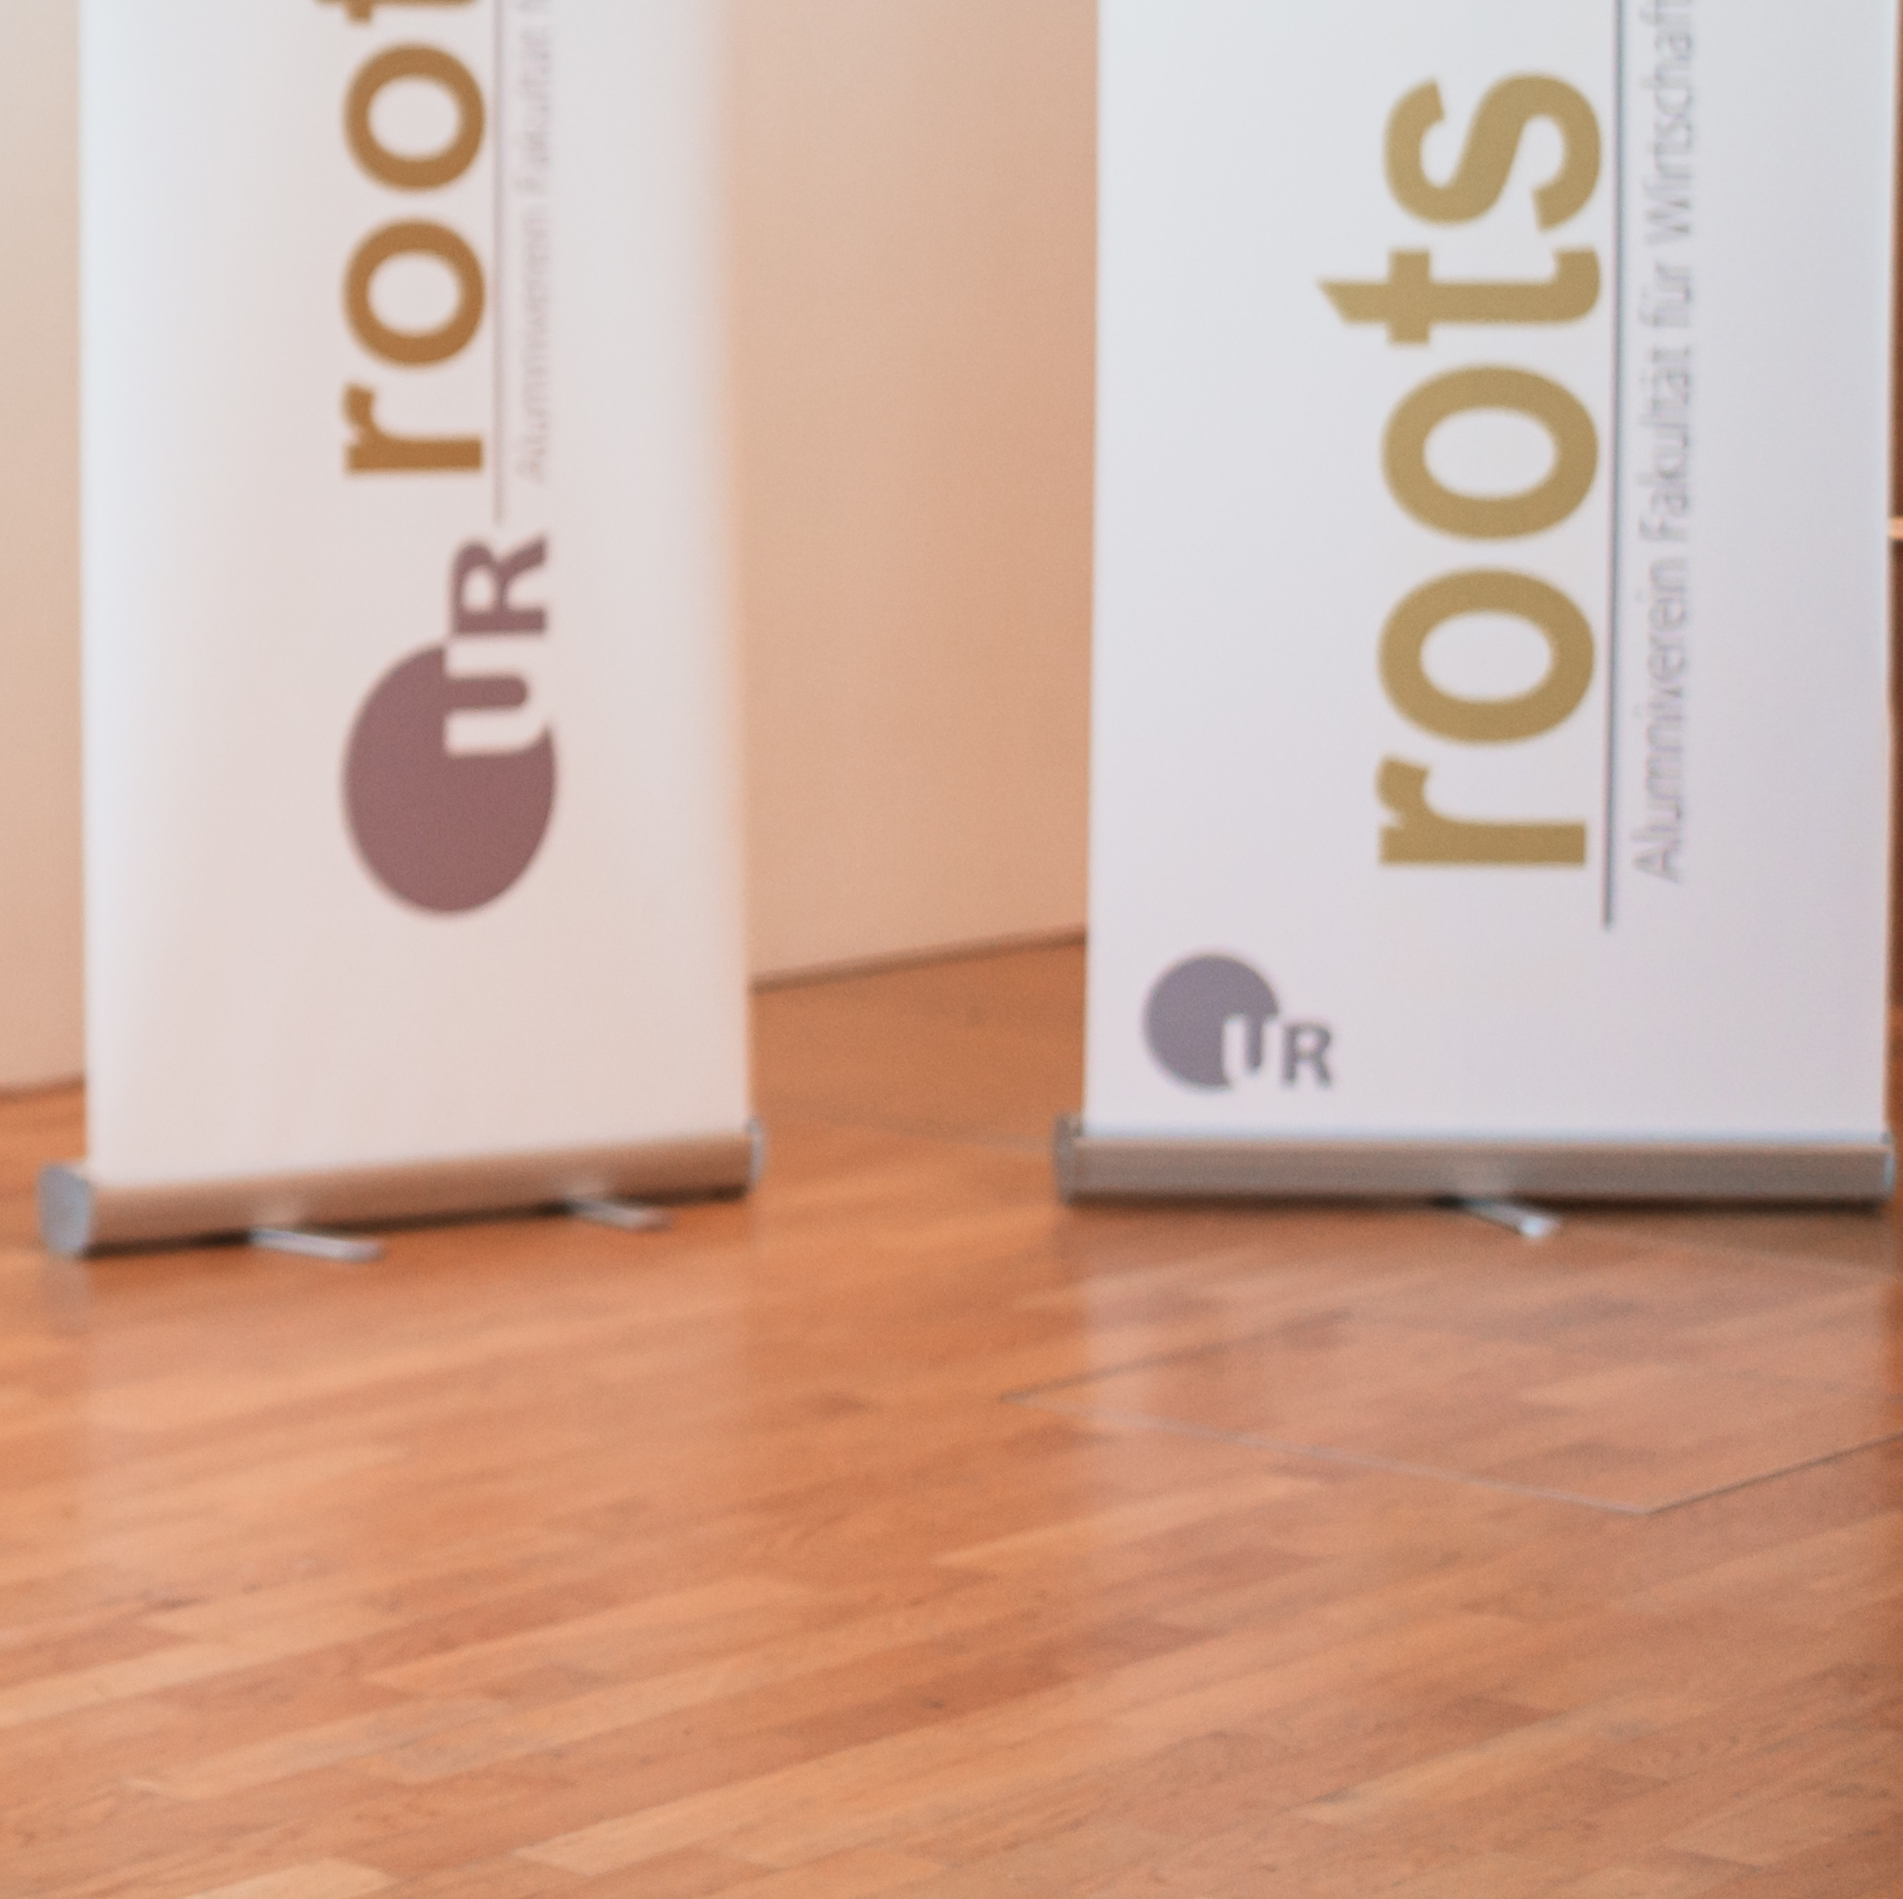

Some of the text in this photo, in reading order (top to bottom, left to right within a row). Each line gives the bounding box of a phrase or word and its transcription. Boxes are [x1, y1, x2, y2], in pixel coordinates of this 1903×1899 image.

[1638, 261, 1694, 331] für
[1315, 71, 1603, 868] roots
[1638, 346, 1693, 544] Fakultät
[1632, 556, 1690, 884] Alumniverein
